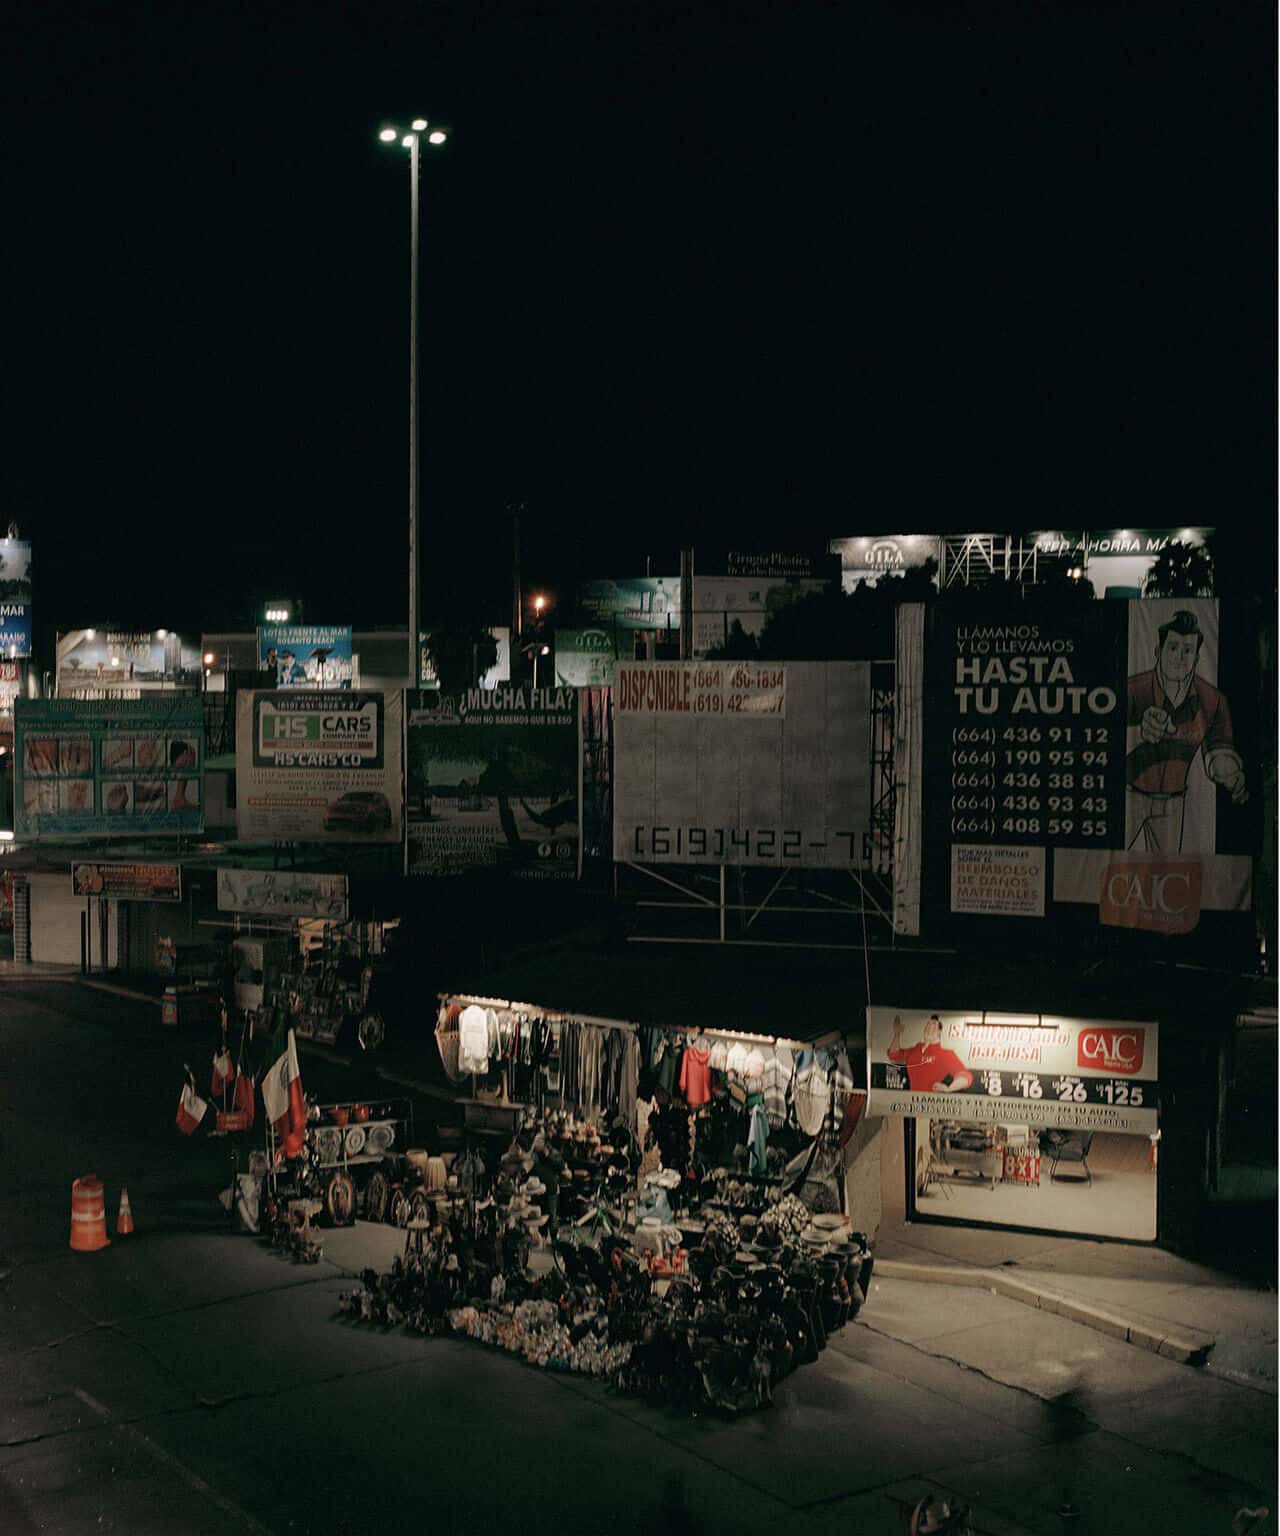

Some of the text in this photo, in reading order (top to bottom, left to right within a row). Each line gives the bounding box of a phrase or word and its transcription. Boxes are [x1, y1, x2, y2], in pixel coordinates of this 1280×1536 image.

[0, 606, 24, 616] MAR
[957, 640, 1074, 653] Y LO LLEVAMOS
[956, 656, 1074, 684] HASTA
[619, 670, 690, 712] DISPONIBLE
[459, 688, 574, 716] ¿MUCHA FILA?
[693, 694, 724, 714] (619)
[954, 687, 1117, 715] TU AUTO
[274, 716, 371, 738] HS CARS
[952, 727, 1108, 745] (664) 436 91 12
[342, 753, 361, 766] CO
[952, 750, 1108, 767] (664) 190 95 94
[951, 772, 1105, 789] (664) 436 38 81
[951, 795, 1107, 813] (664) 436 93 43
[951, 817, 1107, 836] (664) 408 59 55
[958, 864, 1039, 876] REEMBOLSO
[958, 876, 975, 885] DE
[957, 887, 1039, 899] MATERIALES
[1107, 872, 1192, 913] CAIC
[1082, 1032, 1137, 1062] CAIC
[986, 1101, 1054, 1112] ATENDEREMOS
[1075, 1107, 1086, 1115] TU
